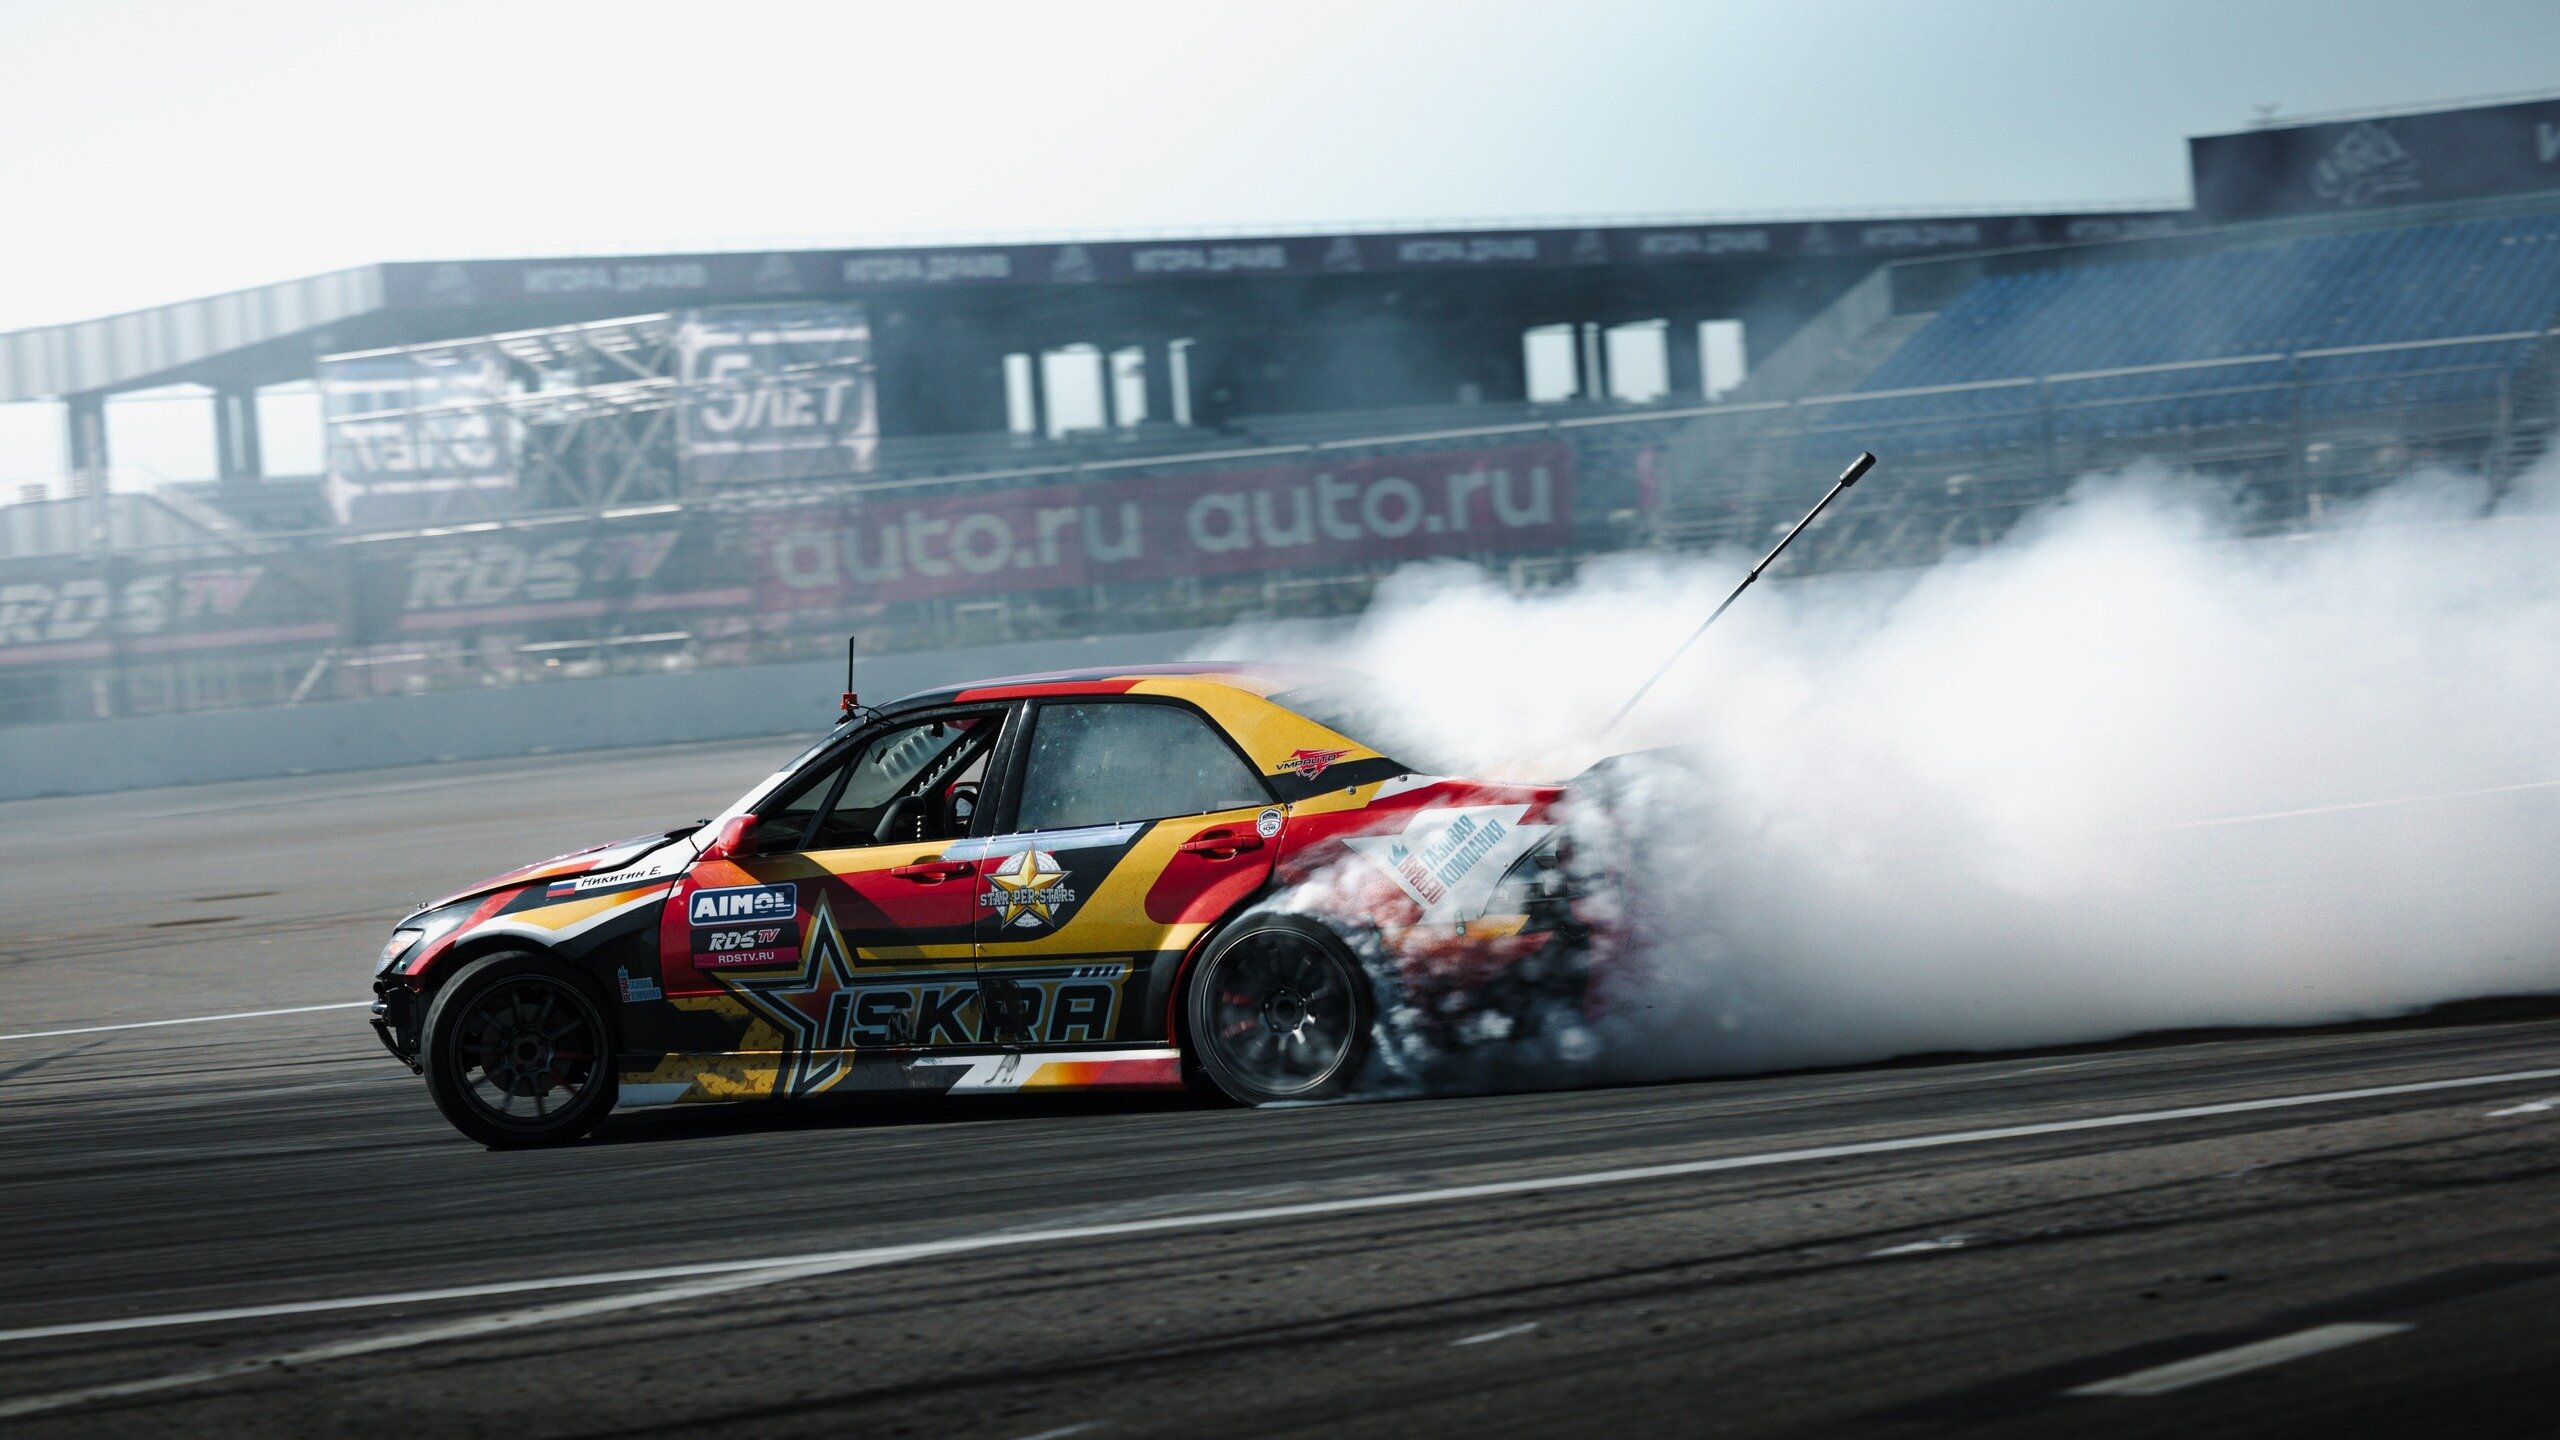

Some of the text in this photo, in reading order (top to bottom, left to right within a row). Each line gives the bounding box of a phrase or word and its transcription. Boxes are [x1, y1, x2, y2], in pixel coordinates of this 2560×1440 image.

[1187, 465, 1553, 554] auto.ru
[405, 537, 592, 610] RDS
[772, 501, 1144, 590] auto.ru
[0, 574, 173, 645] RDS
[1419, 814, 1477, 871] ГАЗОВАЯ
[1437, 818, 1507, 889] КОМПАНИЯ
[693, 891, 792, 919] AIMOL
[980, 890, 1010, 907] STAR
[1038, 888, 1076, 904] STARS
[708, 927, 781, 952] RDS TV
[717, 951, 776, 964] RDSTV.RU
[822, 980, 1118, 1049] ISKRA
